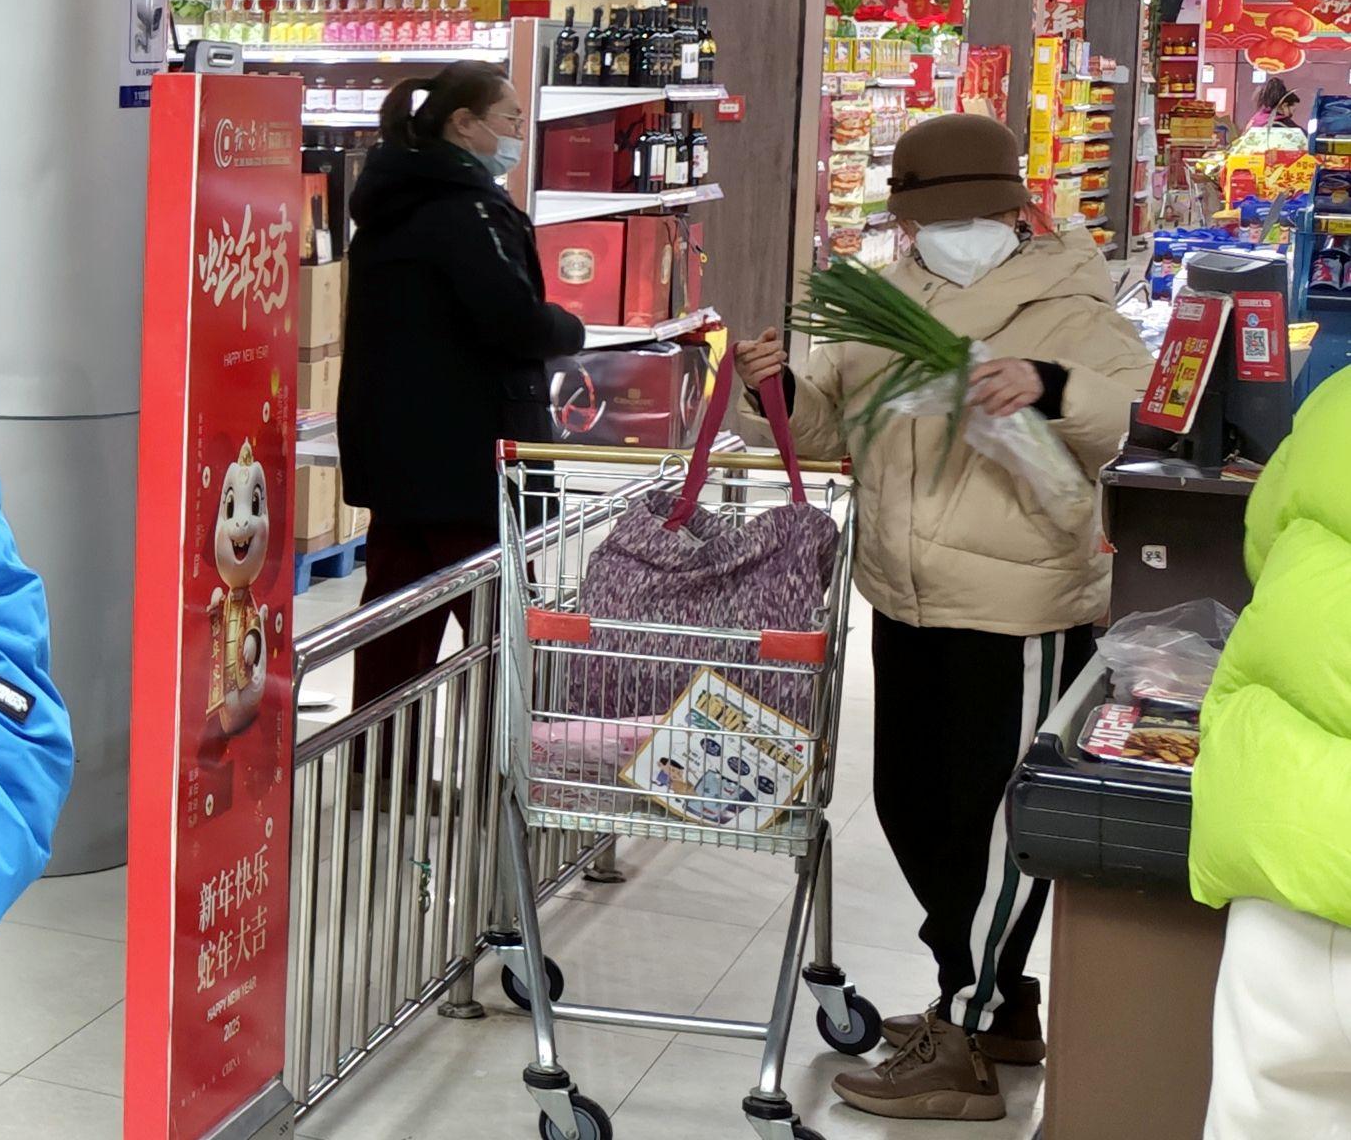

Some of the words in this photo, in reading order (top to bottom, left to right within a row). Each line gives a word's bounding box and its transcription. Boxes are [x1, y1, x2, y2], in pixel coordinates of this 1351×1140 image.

[199, 844, 269, 933] 新年快乐
[197, 905, 268, 993] 蛇年大吉
[207, 999, 228, 1022] HAPPY
[226, 988, 241, 1011] NEW
[239, 975, 257, 999] YEAR
[223, 1015, 241, 1042] 2025
